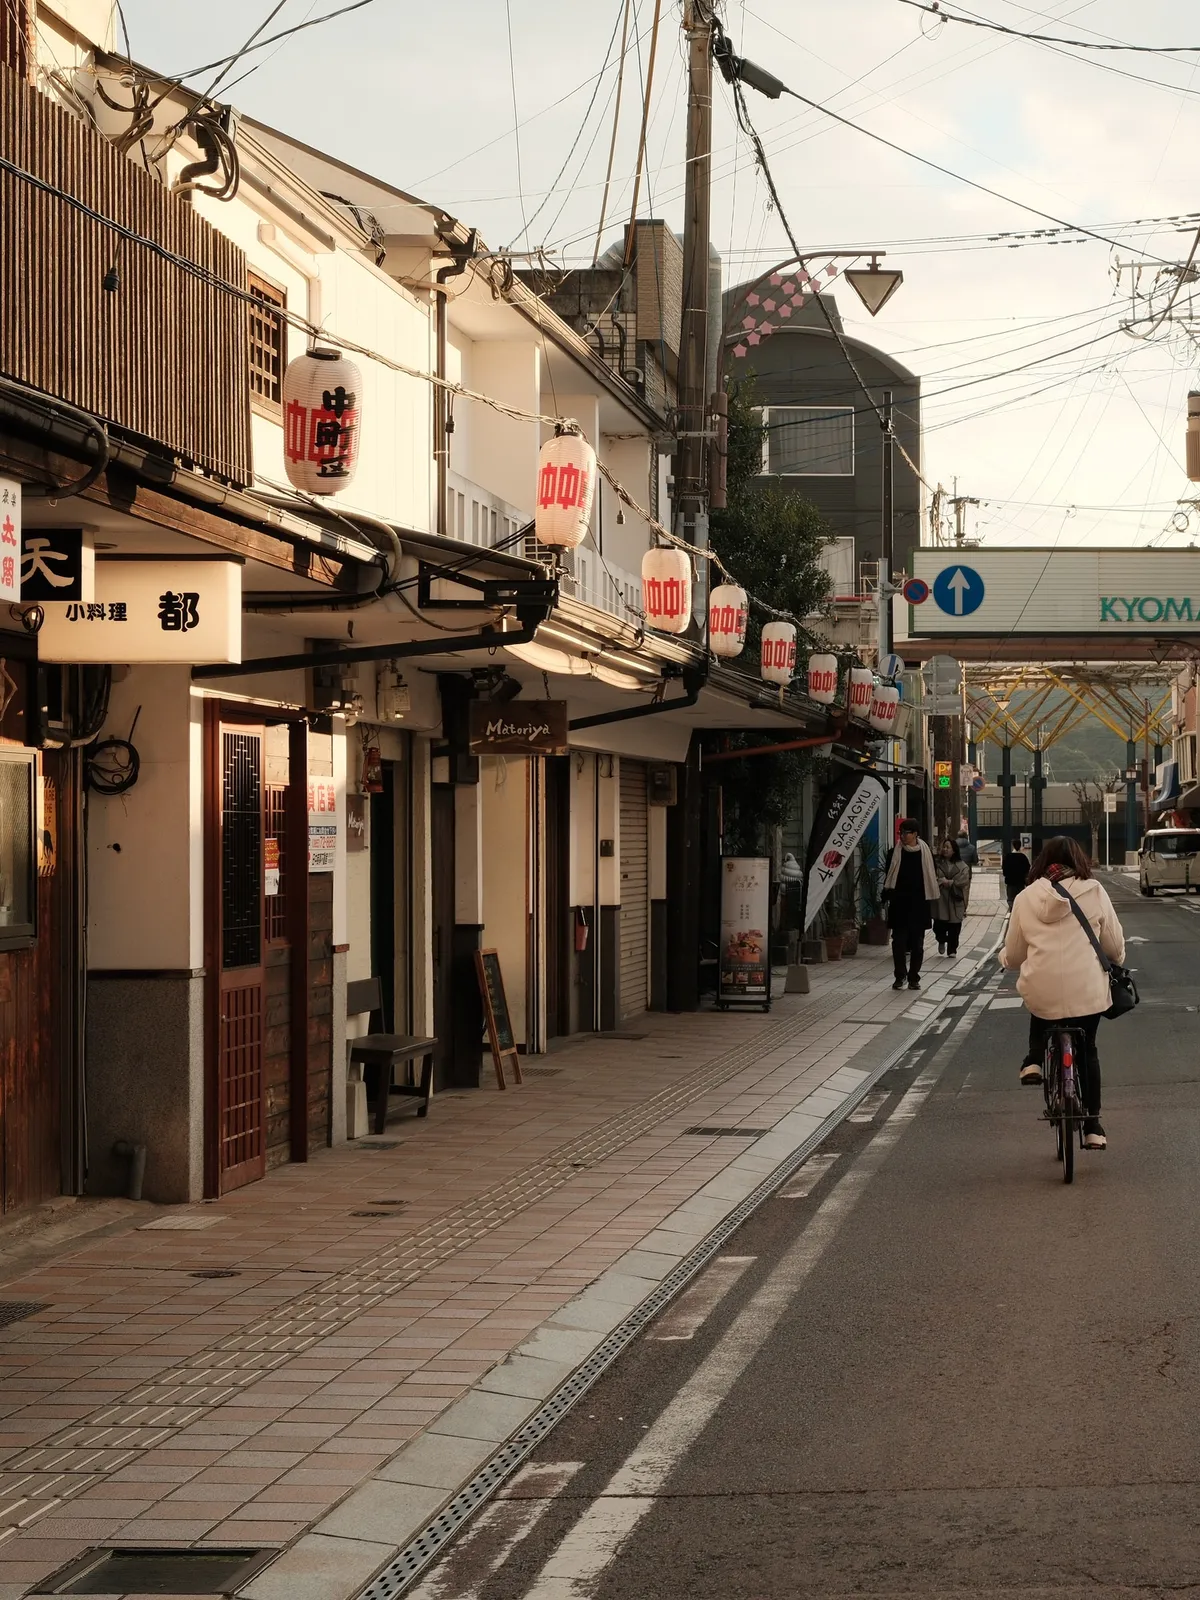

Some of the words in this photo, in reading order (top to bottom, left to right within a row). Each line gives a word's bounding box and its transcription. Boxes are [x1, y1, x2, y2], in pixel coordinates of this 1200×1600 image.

[65, 602, 128, 622] 小料理
[157, 590, 200, 632] 都
[486, 719, 550, 741] Matoriya
[832, 789, 872, 848] SAGAGYU
[855, 794, 880, 834] Anniversary
[1022, 837, 1030, 847] P
